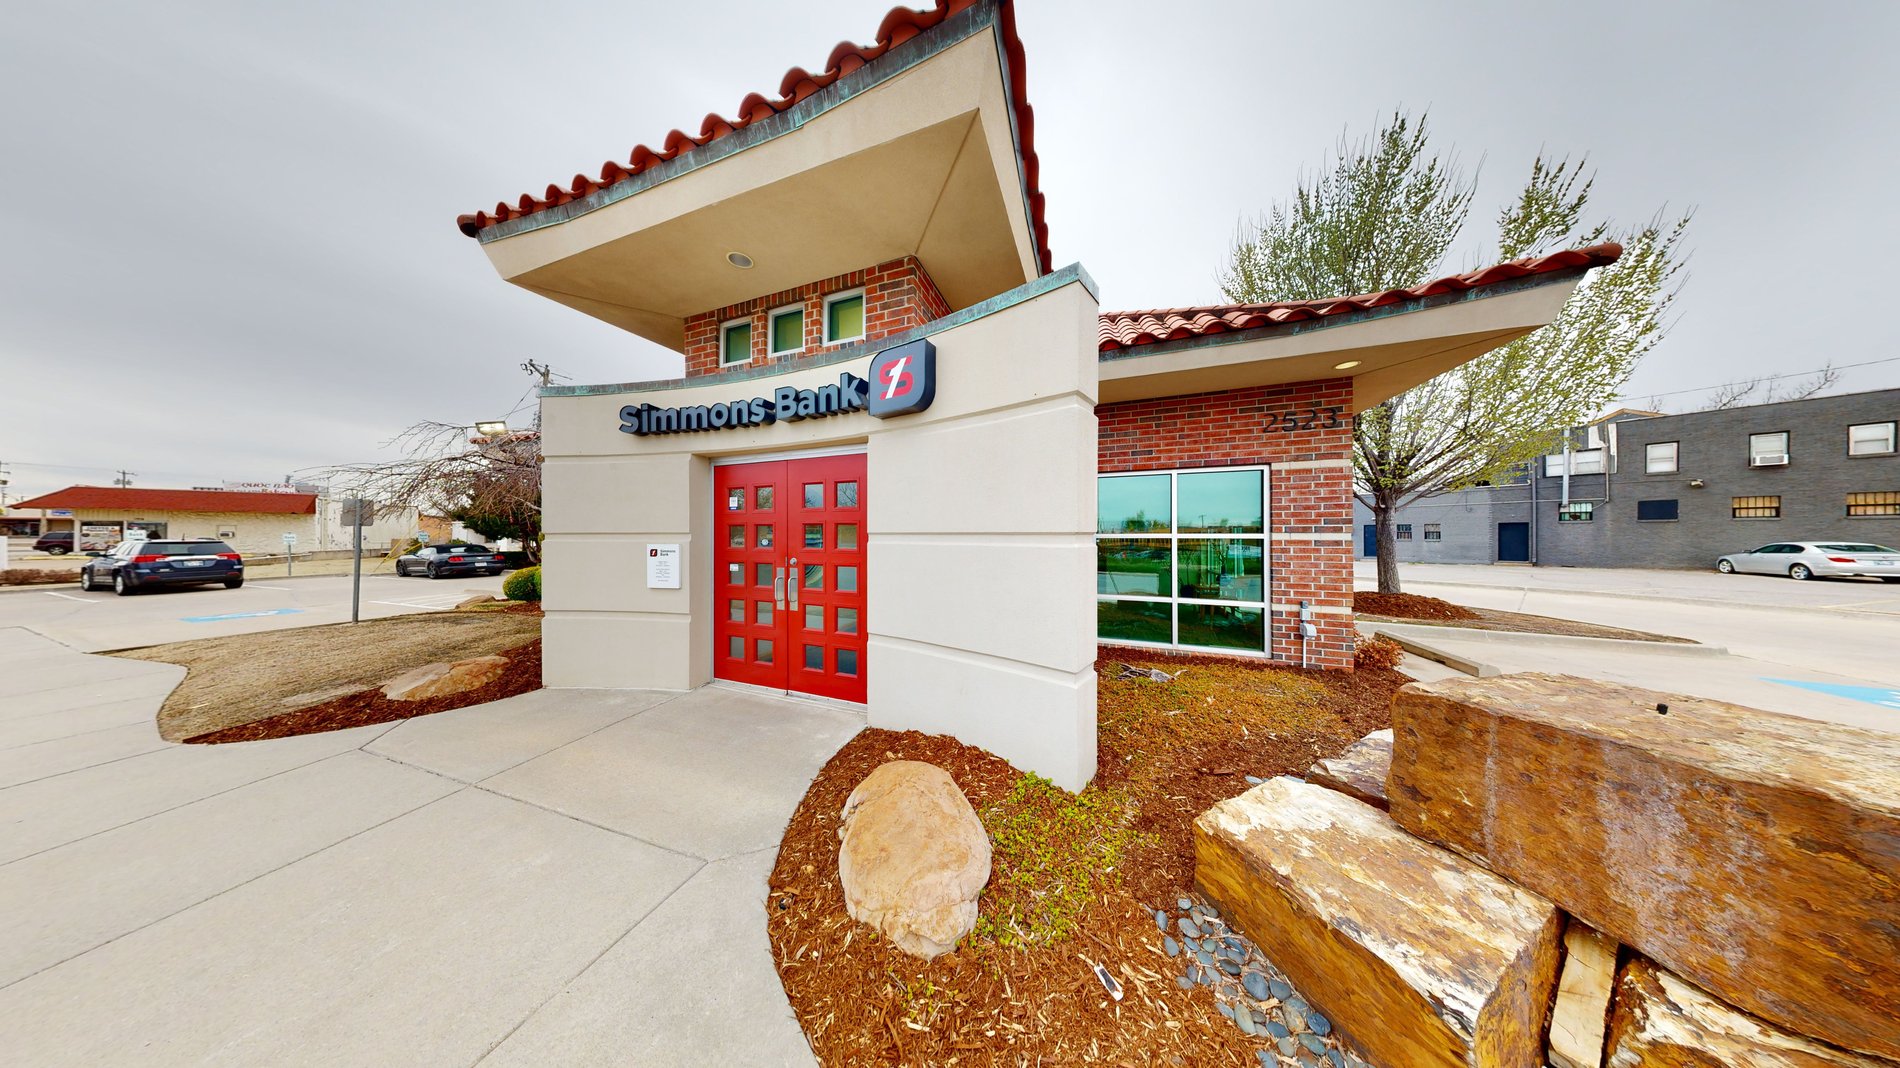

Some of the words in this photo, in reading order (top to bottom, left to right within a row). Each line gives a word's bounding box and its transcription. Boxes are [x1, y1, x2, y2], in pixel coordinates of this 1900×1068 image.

[619, 397, 773, 437] Simmons
[774, 372, 868, 422] Bank
[1262, 408, 1338, 433] 2523
